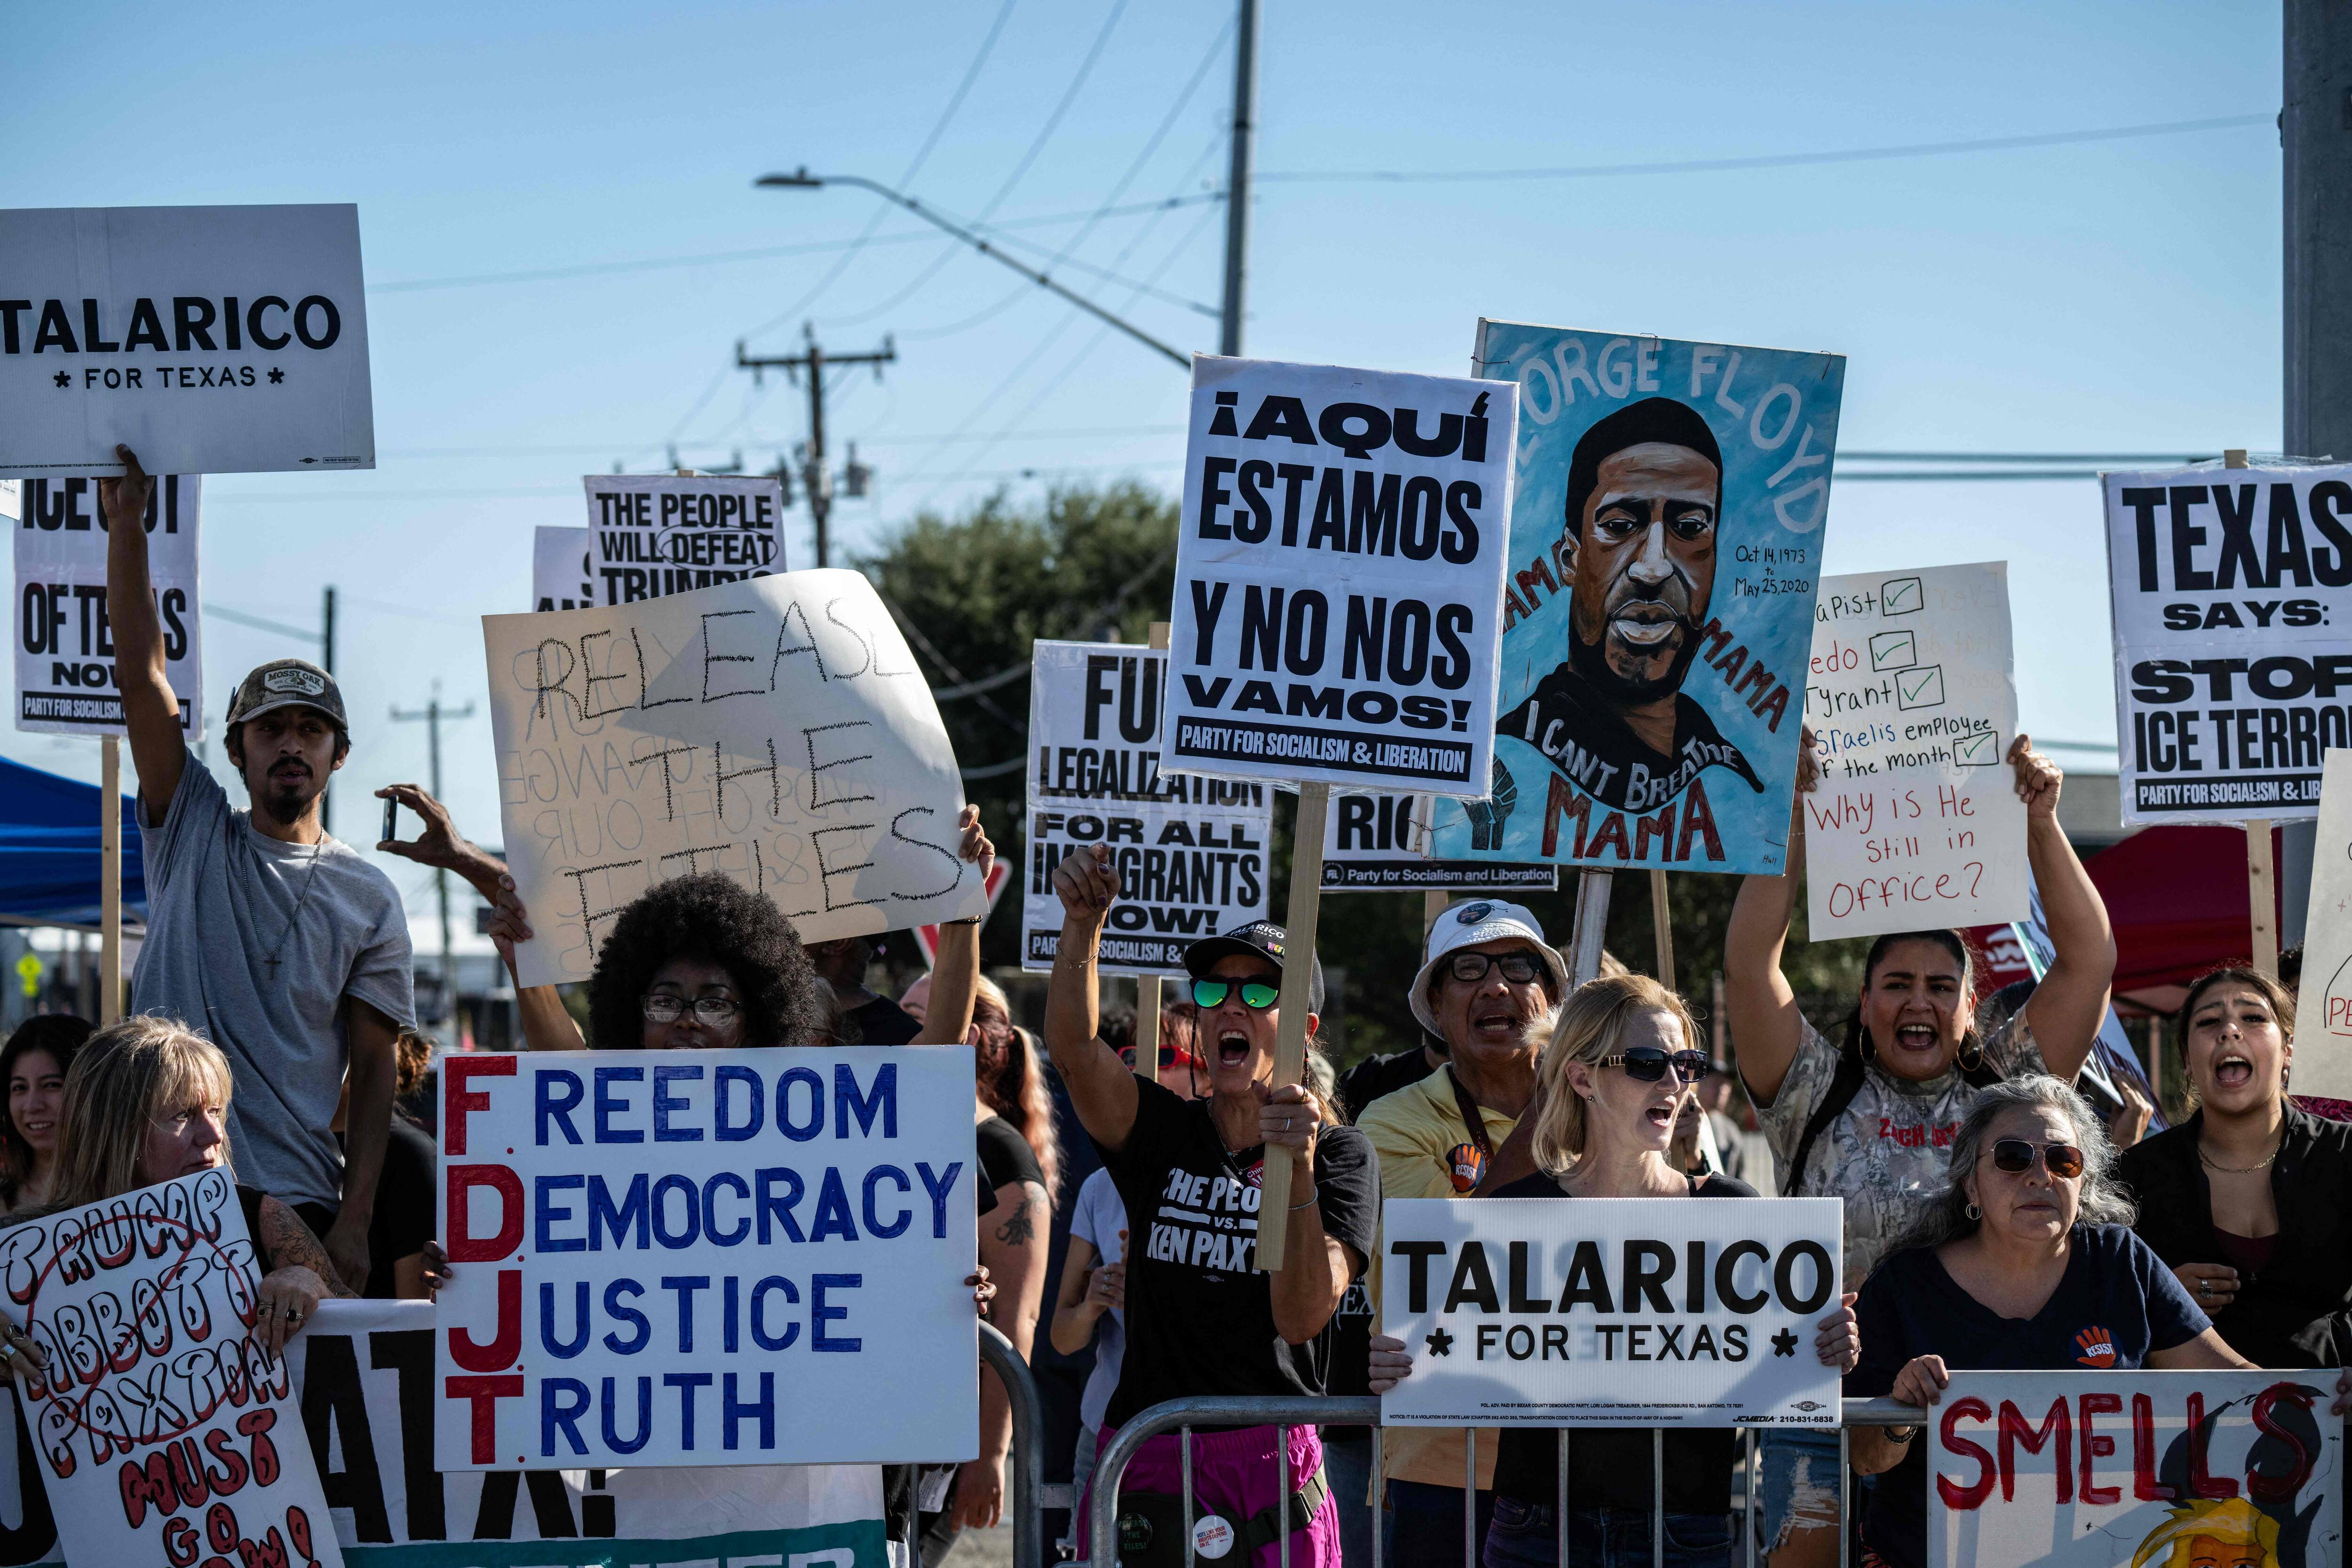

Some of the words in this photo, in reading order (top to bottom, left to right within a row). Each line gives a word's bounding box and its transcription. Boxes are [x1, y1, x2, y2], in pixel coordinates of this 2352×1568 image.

[0, 294, 341, 354] TALARICO
[86, 368, 143, 389] FOR
[157, 366, 255, 388] TEXAS
[1208, 391, 1491, 462] ¡AQUÍ
[1516, 338, 1662, 467] ORGE
[1690, 345, 1829, 533] FLOYD
[23, 478, 90, 530] ICE
[596, 493, 652, 526] THE
[661, 493, 773, 529] PEOPLE
[1199, 456, 1481, 565] ESTAMOS
[600, 532, 663, 563] WILL
[673, 533, 775, 565] DEFEAT
[2122, 480, 2352, 592] TEXAS
[1765, 566, 1774, 575] to
[23, 582, 68, 654] OF
[74, 585, 187, 661] TES
[1190, 580, 1229, 666] Y
[1239, 585, 1328, 676] NO
[1342, 595, 1472, 690] NOS
[2163, 598, 2330, 630] SAYS:
[52, 662, 119, 688] NO
[268, 670, 301, 681] MOSSY
[302, 673, 321, 687] OAK
[1701, 617, 1789, 733] MAMA
[1812, 640, 1858, 674] edo
[24, 697, 54, 716] PARTY
[55, 699, 72, 717] FOR
[73, 700, 120, 720] SOCIALISM
[1083, 655, 1168, 743] FU
[1181, 674, 1472, 732] VAMOS!
[1806, 680, 1891, 717] Tyrant
[1181, 724, 1232, 749] PARTY
[1233, 729, 1263, 755] FOR
[1267, 732, 1349, 762] SOCIALISM
[1352, 741, 1372, 765] &
[1375, 743, 1465, 773] LIBERATION
[1525, 700, 1539, 740] I
[1542, 719, 1619, 796] CANT
[1844, 758, 1878, 778] the
[1885, 745, 1950, 771] month
[2134, 710, 2202, 772] ICE
[2209, 706, 2352, 770] TERRO
[629, 721, 875, 822] THE
[2140, 784, 2182, 805] PARTY
[2184, 782, 2209, 804] FOR
[2210, 780, 2280, 804] SOCIALISM
[2282, 780, 2299, 801] &
[1035, 813, 1144, 844] FOR
[1157, 820, 1260, 850] ALL
[1541, 771, 1726, 862] MAMA
[1808, 791, 1873, 835] Why
[1940, 784, 1975, 818] He
[1948, 828, 1974, 849] in
[1032, 843, 1261, 907] IGRANTS
[1348, 869, 1380, 883] Party
[1383, 868, 1400, 880] for
[1403, 869, 1462, 881] Socialism
[1465, 869, 1488, 881] and
[1491, 869, 1552, 882] Liberation
[1104, 905, 1220, 935] OW!
[1230, 924, 1284, 939] TALARICO
[1100, 940, 1163, 962] SOCIALISM
[1166, 945, 1182, 962] &
[1207, 1177, 1261, 1212] PEO
[1455, 1164, 1477, 1180] RESIST
[0, 1171, 227, 1305] TRUMP
[1147, 1222, 1191, 1264] KEN
[1192, 1231, 1263, 1275] PAX
[1390, 1239, 1834, 1314] TALARICO
[25, 1239, 259, 1401] ABBOTT
[1477, 1324, 1569, 1361] FOR
[1595, 1324, 1748, 1362] TEXAS
[2085, 1343, 2114, 1357] RESIST
[39, 1335, 289, 1479] PAXTON
[119, 1408, 280, 1529] MUST
[1937, 1382, 2315, 1511] SMELLS
[162, 1502, 239, 1568] GO
